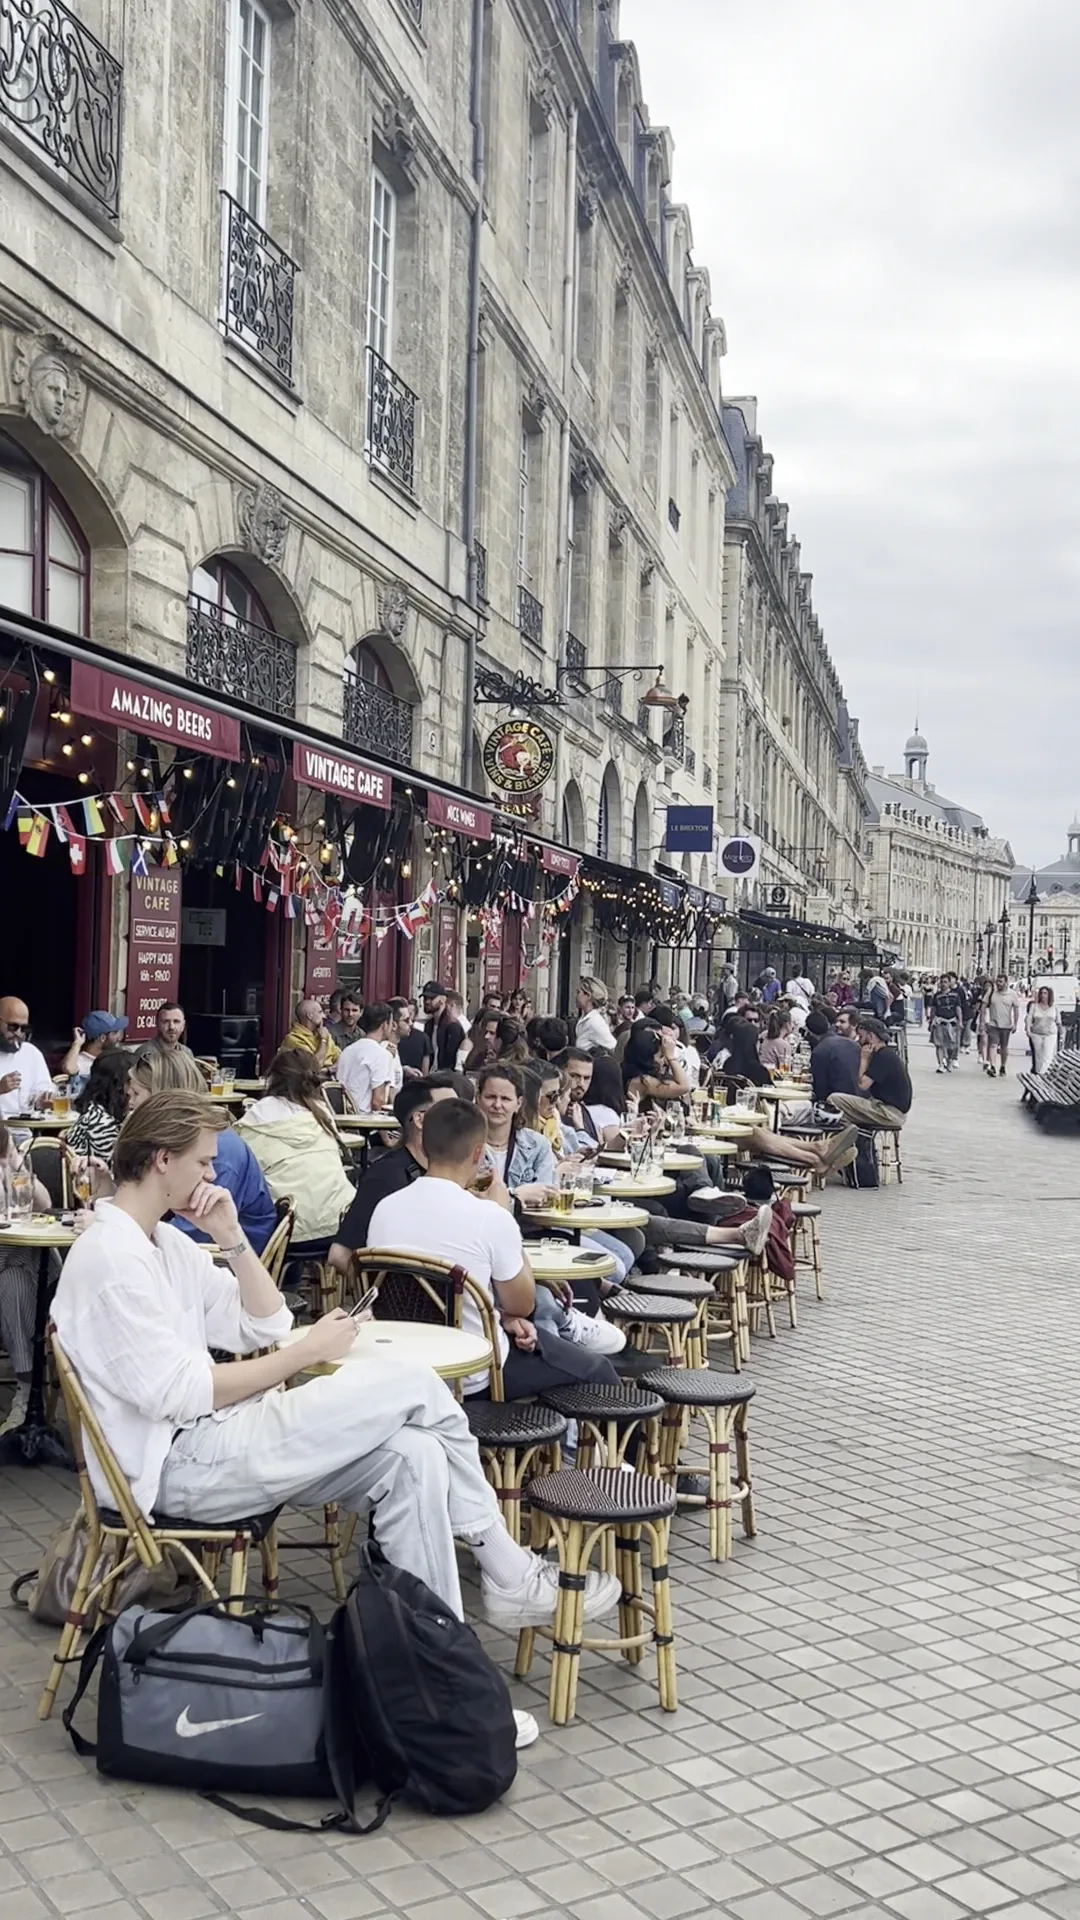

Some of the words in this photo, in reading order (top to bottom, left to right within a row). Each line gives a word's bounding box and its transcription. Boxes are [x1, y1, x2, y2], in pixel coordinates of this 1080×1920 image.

[111, 687, 173, 728] AMAZING
[177, 707, 212, 741] BEERS
[485, 722, 530, 753] VINTAGE
[305, 750, 355, 791] VINTAGE
[357, 770, 384, 800] CAFE
[485, 759, 504, 785] VINS
[504, 780, 513, 790] &
[447, 804, 459, 823] NICE
[460, 809, 476, 828] WINES
[501, 803, 532, 815] BAR
[670, 824, 678, 832] LE
[679, 824, 709, 832] BRIXTON
[136, 876, 178, 894] VINTAGE
[144, 895, 170, 911] CAFE
[135, 925, 157, 938] SERVICE
[157, 926, 165, 938] AU
[165, 926, 176, 939] BAR
[138, 952, 157, 965] HAPPY
[157, 953, 174, 965] HOUR
[136, 1016, 146, 1028] DE
